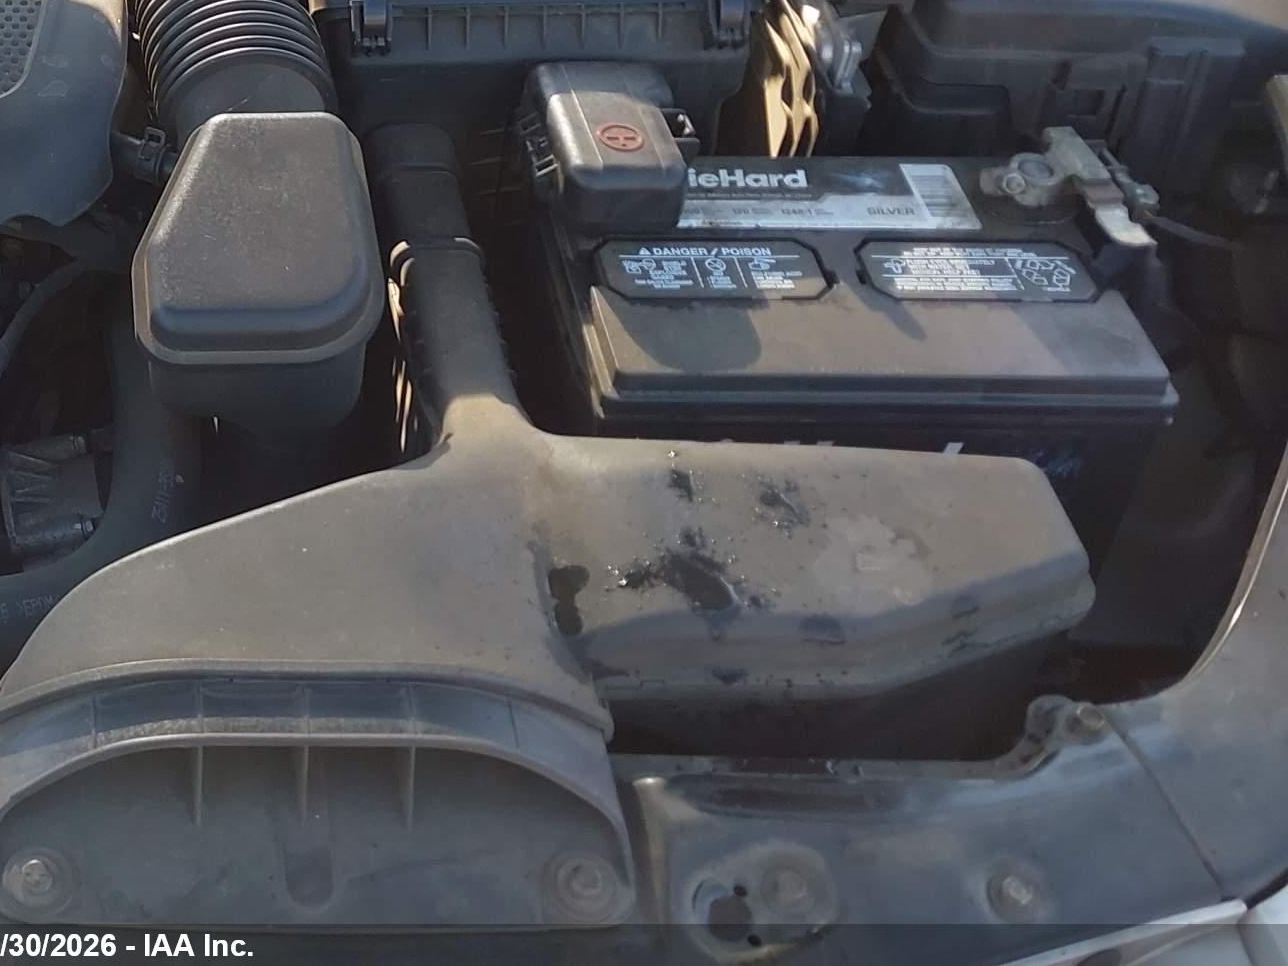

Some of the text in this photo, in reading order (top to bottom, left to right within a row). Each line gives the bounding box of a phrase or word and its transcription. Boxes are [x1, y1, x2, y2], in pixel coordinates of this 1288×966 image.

[686, 168, 808, 187] ieHard
[867, 207, 915, 216] SILVER
[652, 247, 708, 256] DANGER
[721, 247, 772, 256] POISON
